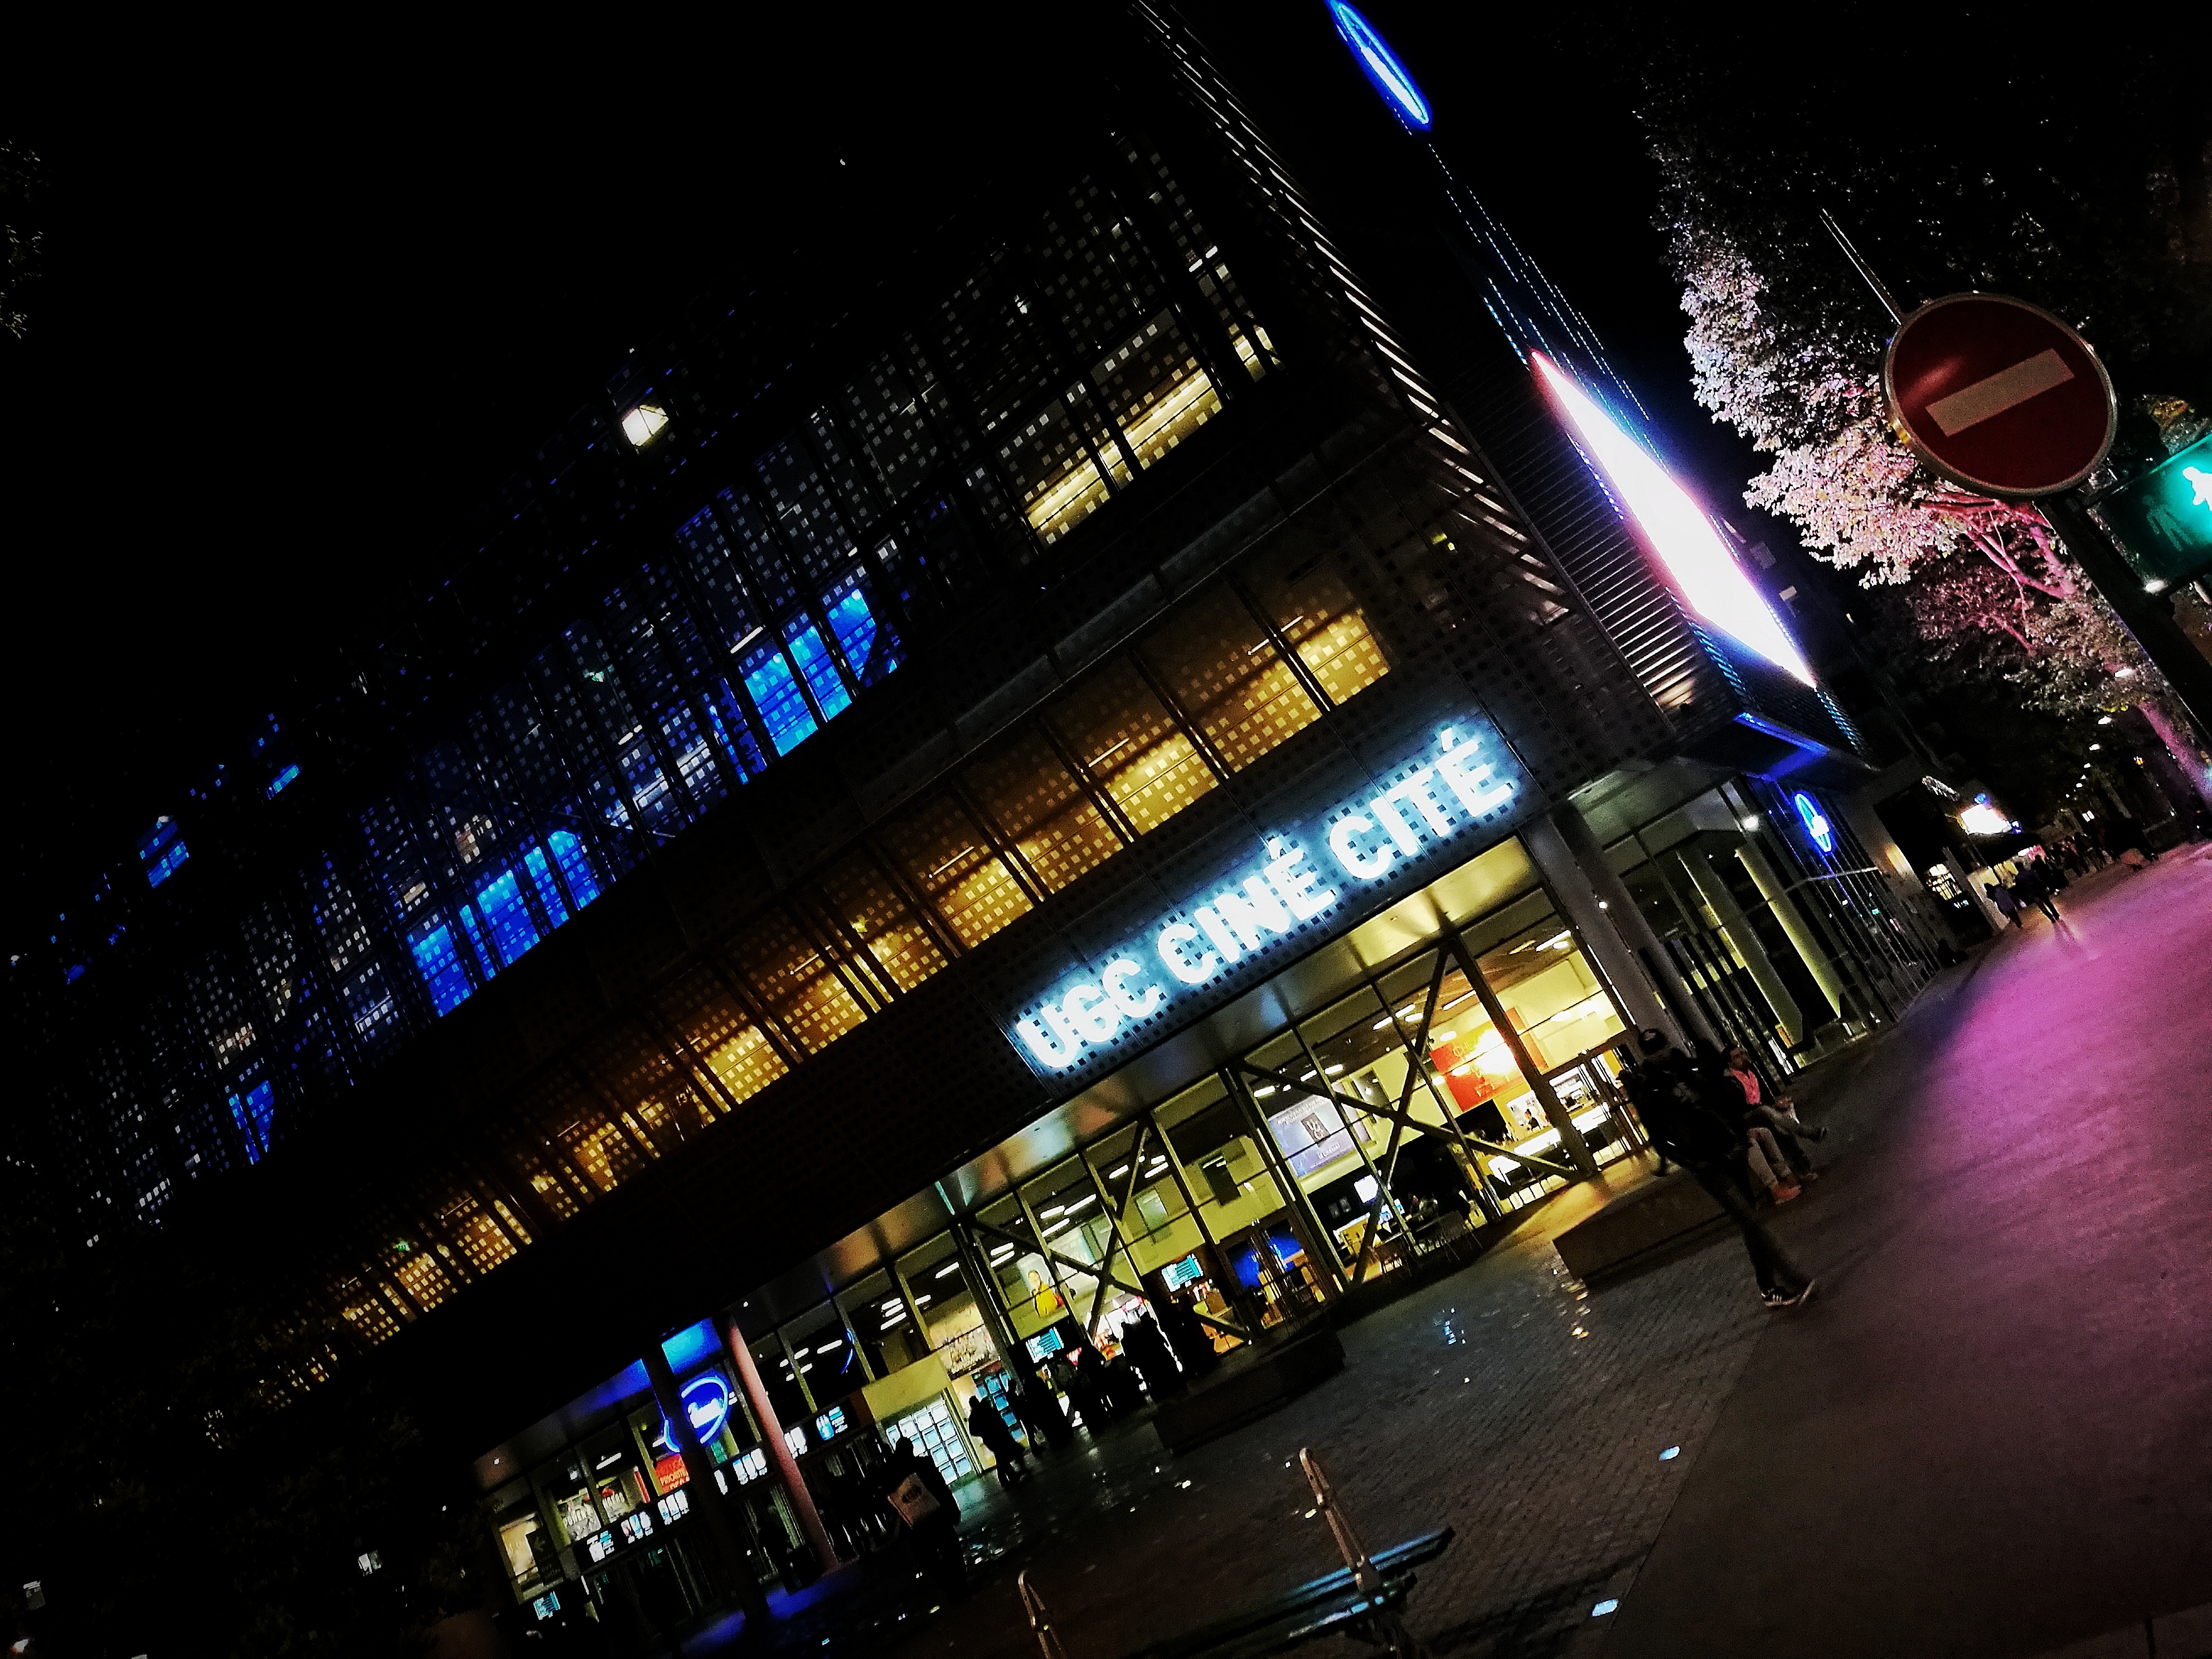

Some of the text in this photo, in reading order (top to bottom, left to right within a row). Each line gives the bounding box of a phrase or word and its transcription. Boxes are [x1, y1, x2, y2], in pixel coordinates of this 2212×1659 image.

[1016, 726, 1512, 1068] UGC CINÉ CITÉ
